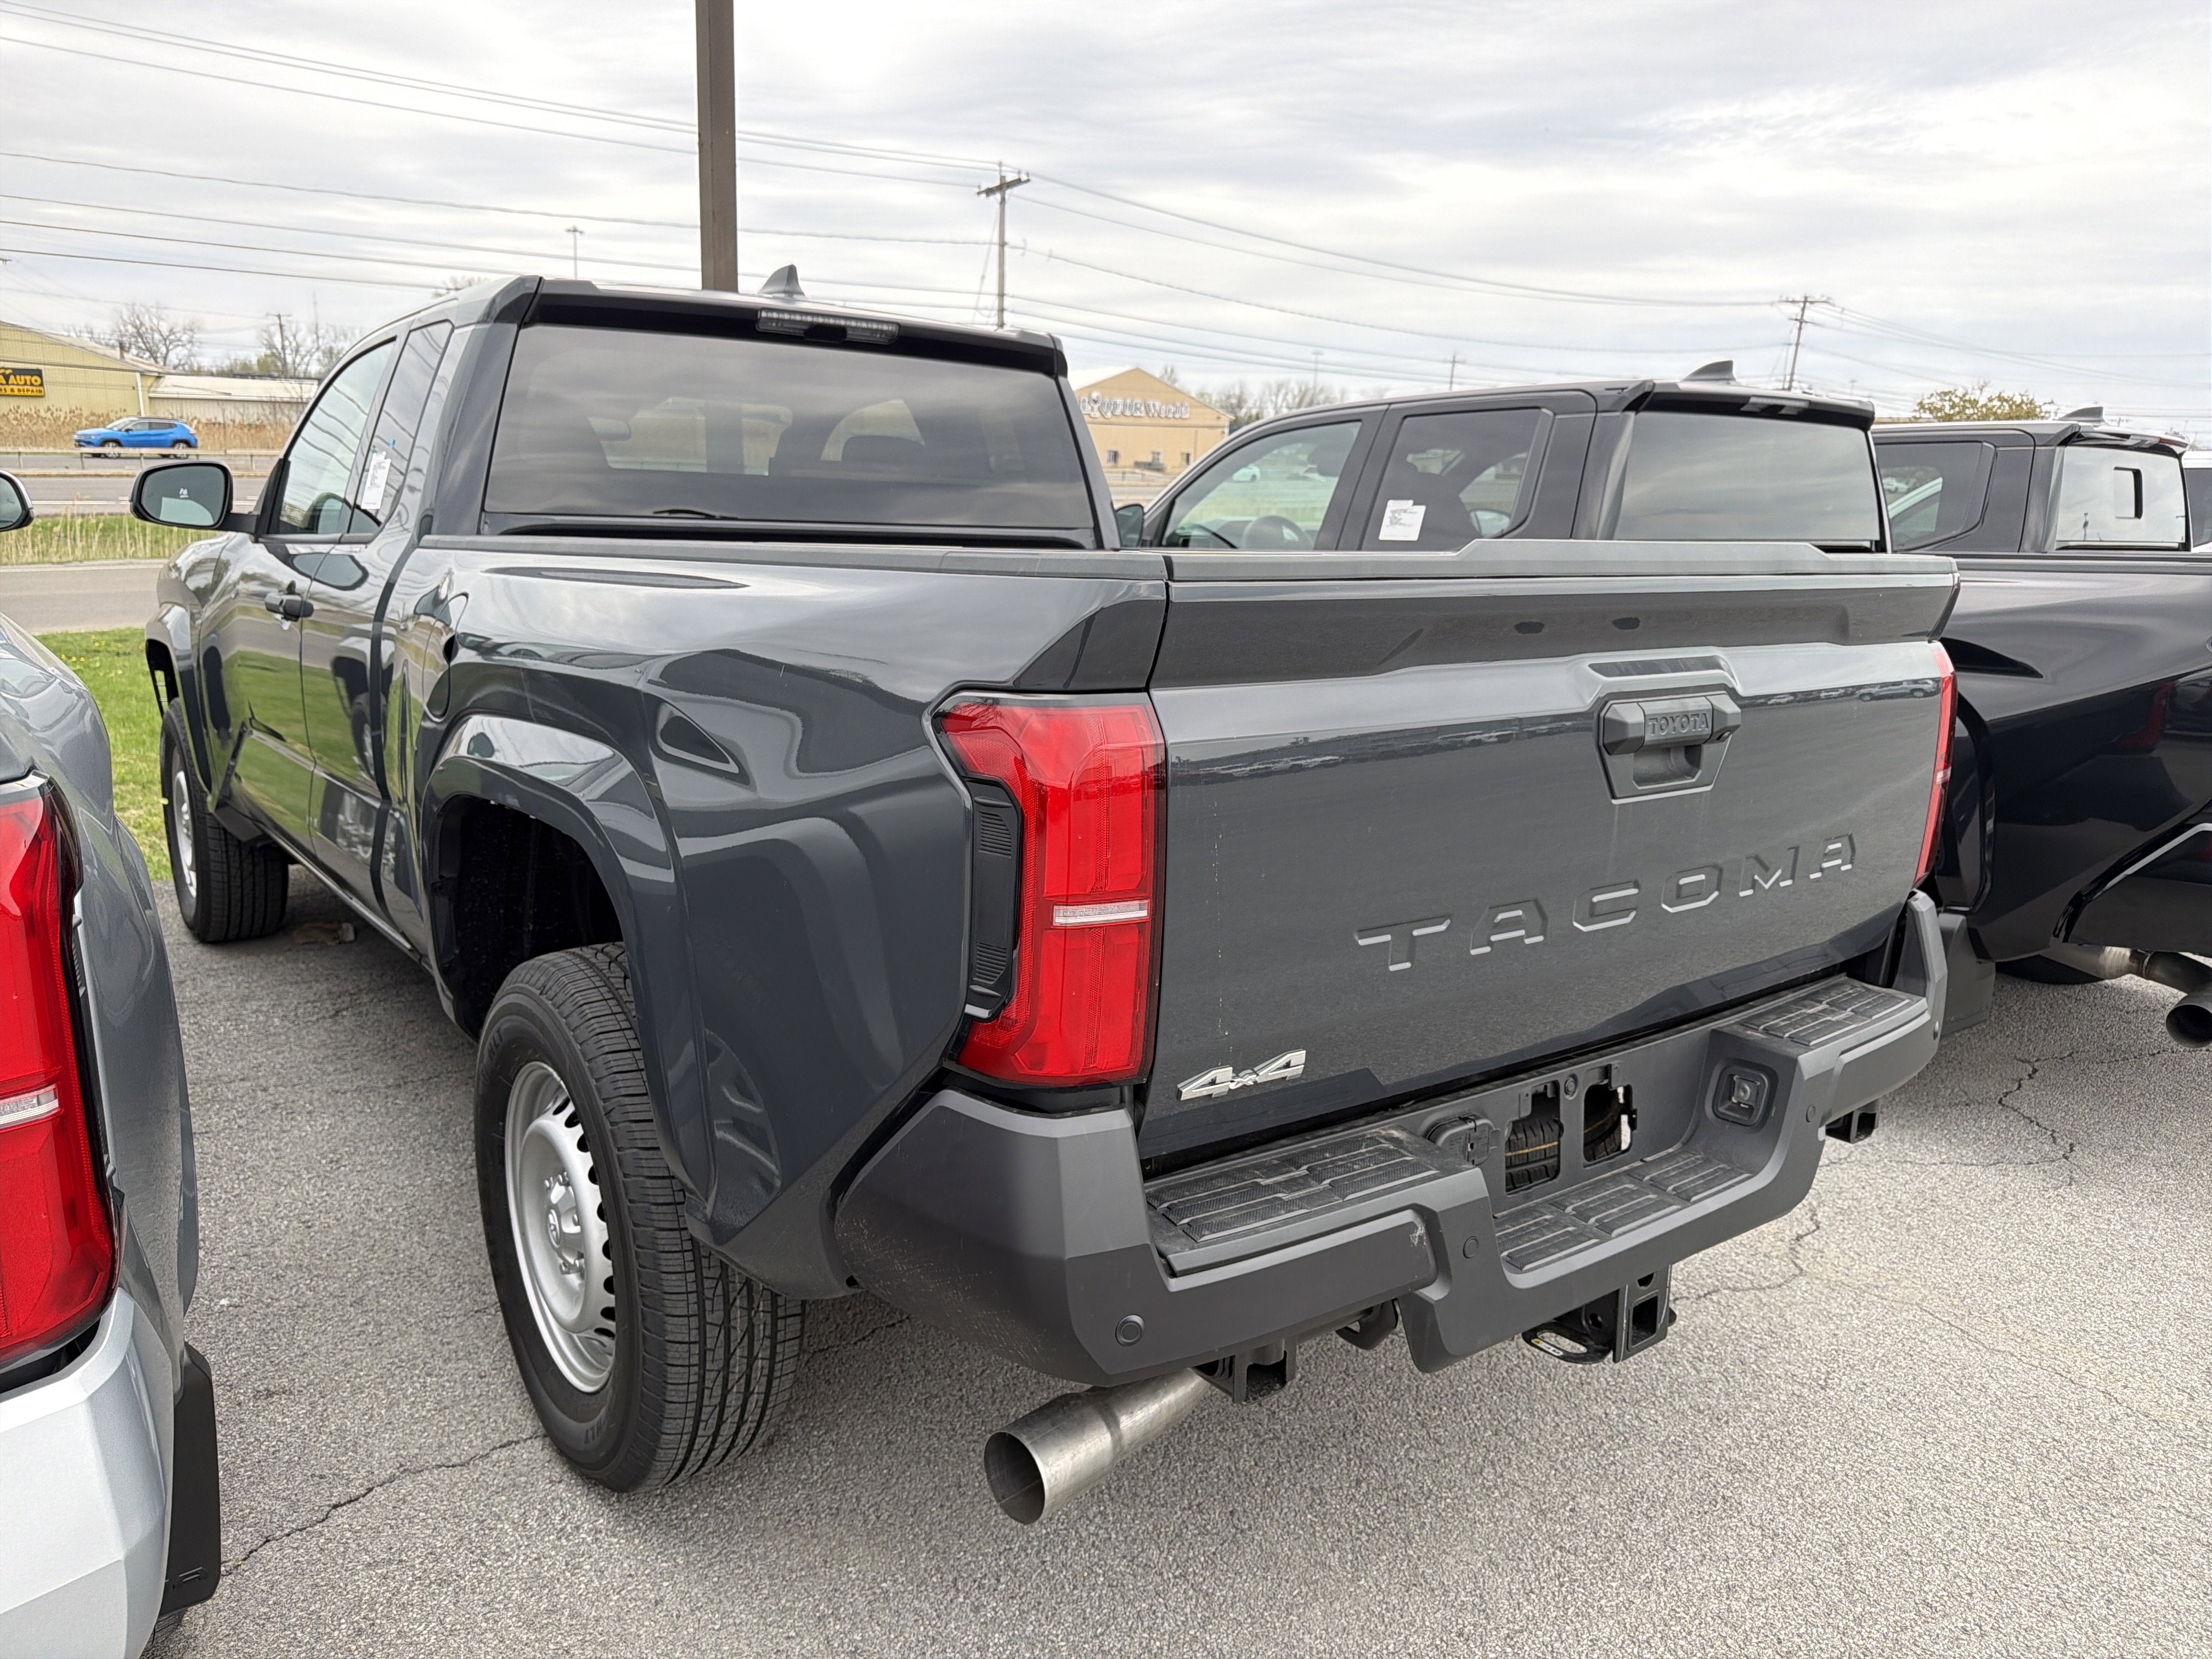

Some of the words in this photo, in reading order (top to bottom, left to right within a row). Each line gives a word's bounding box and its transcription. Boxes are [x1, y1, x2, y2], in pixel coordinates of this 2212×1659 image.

[9, 375, 41, 386] AUTO
[1648, 713, 1709, 736] TOYOTA
[1355, 832, 1856, 971] TACOMA
